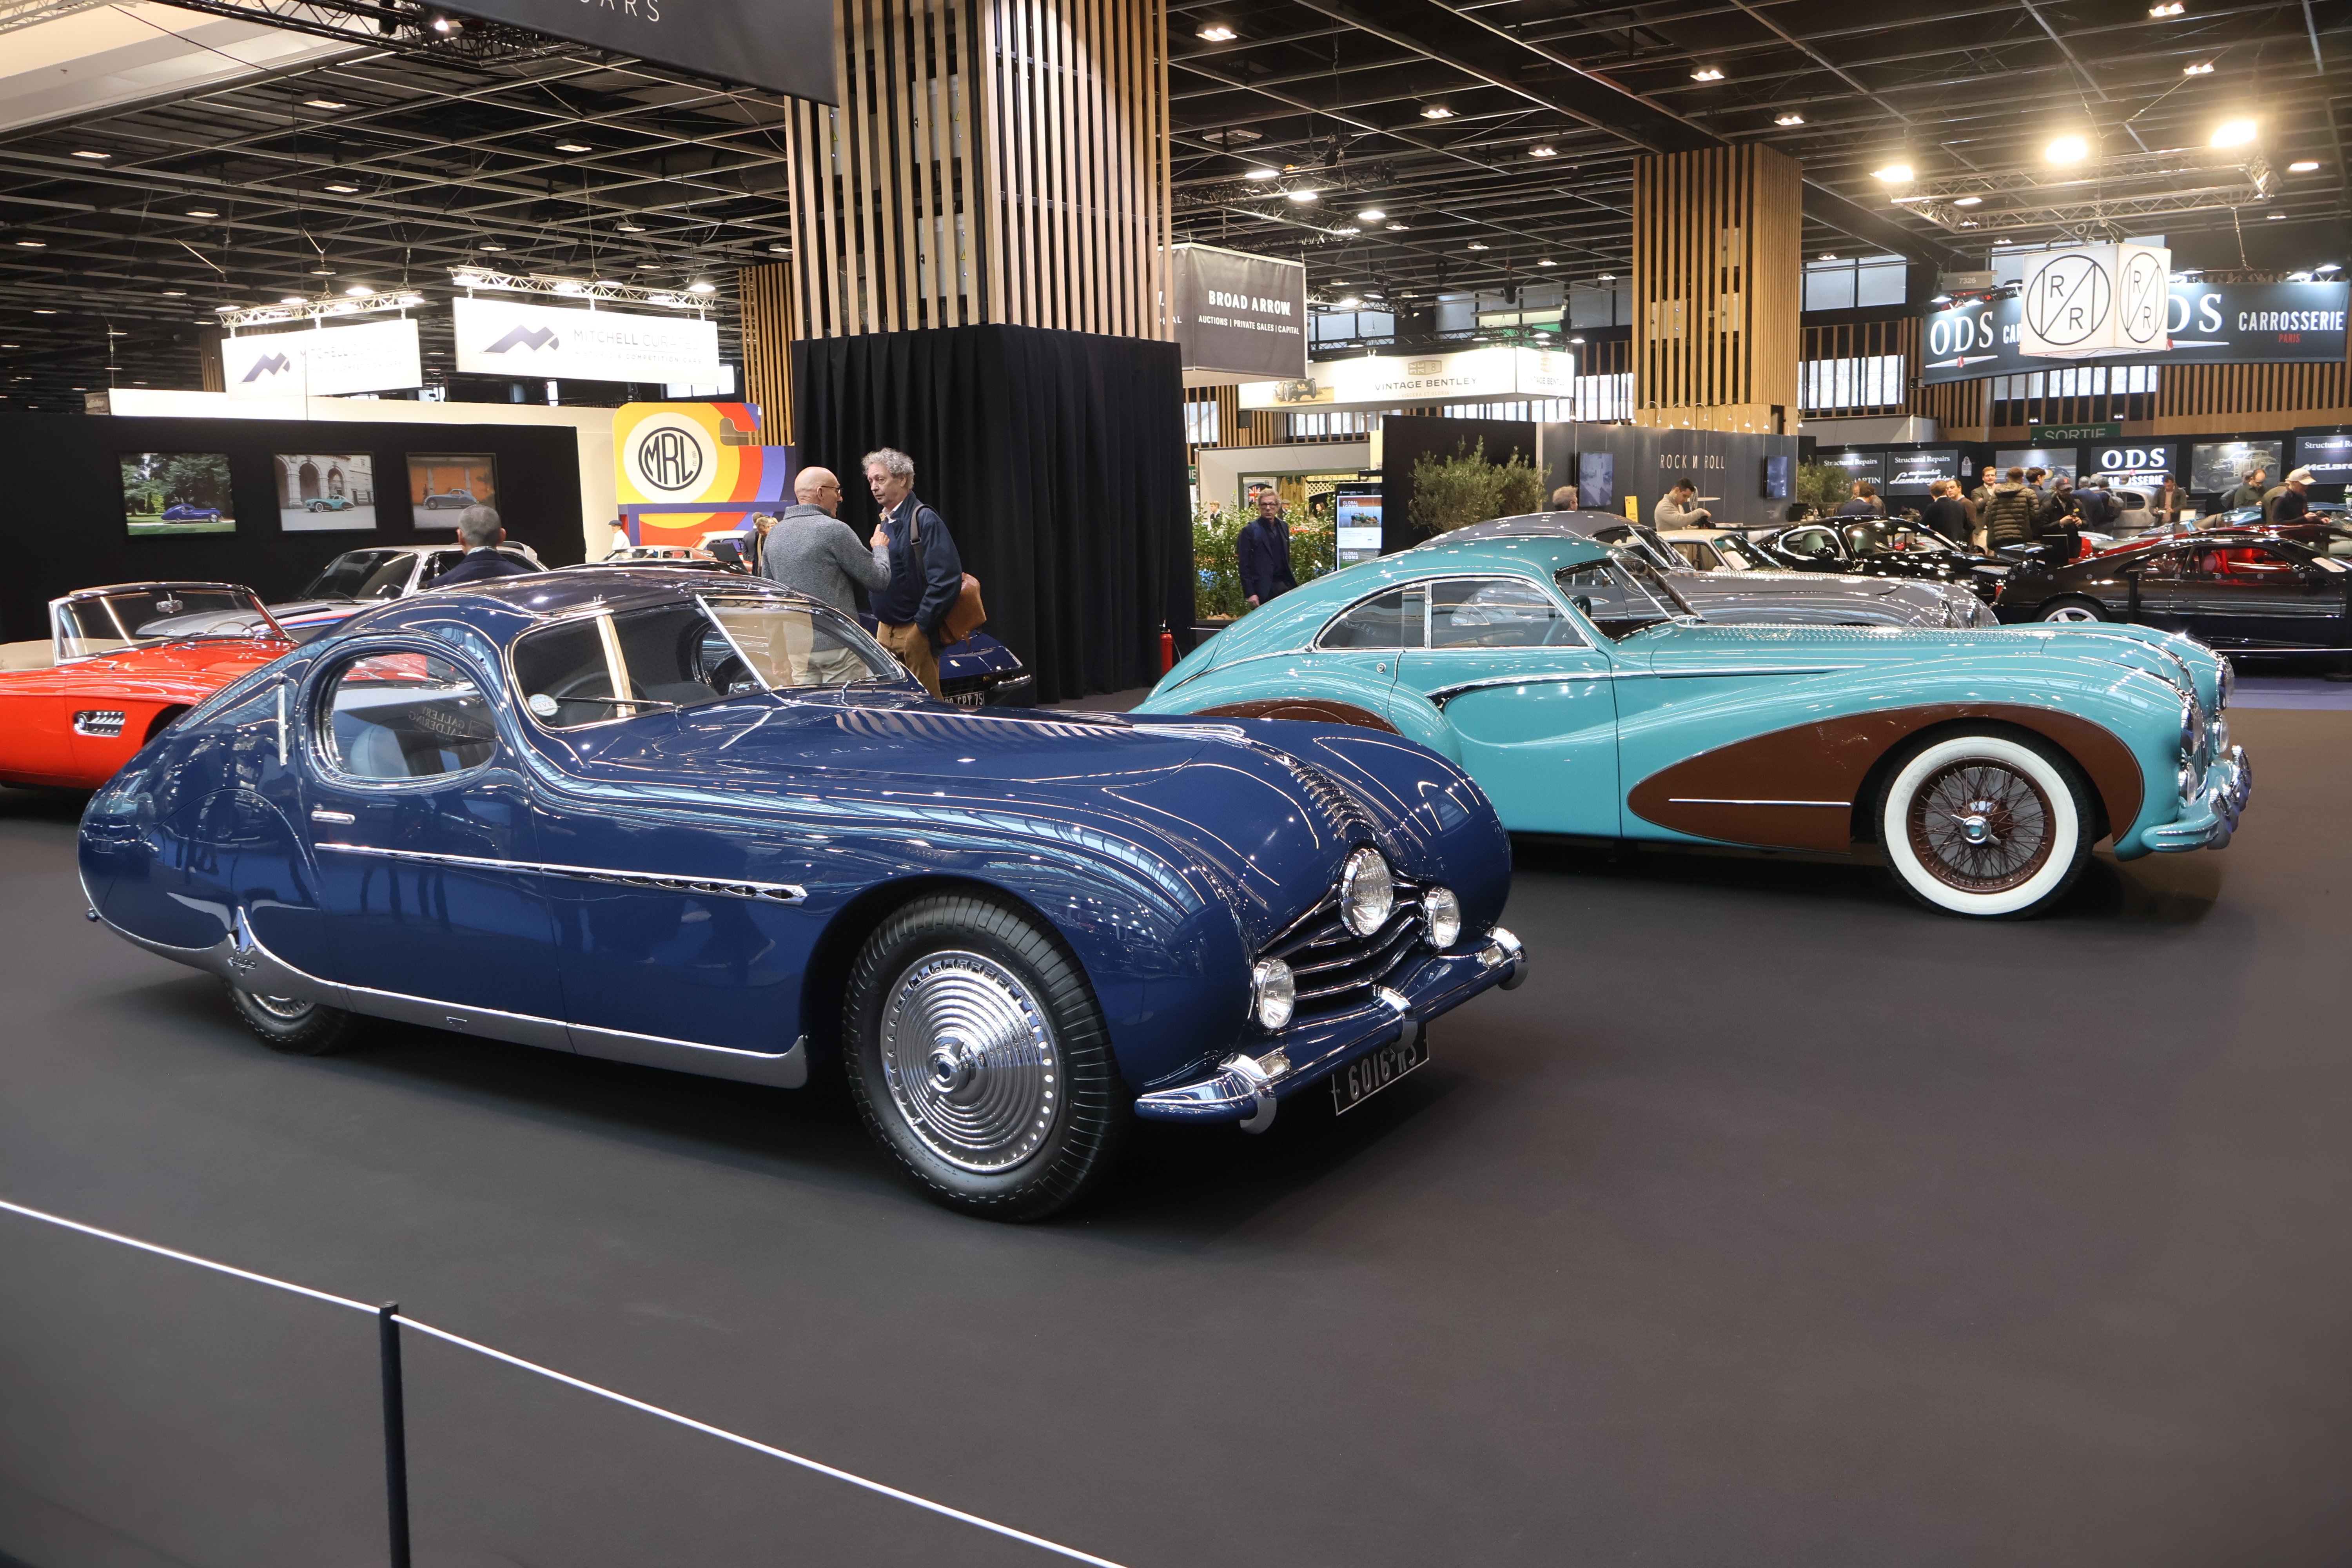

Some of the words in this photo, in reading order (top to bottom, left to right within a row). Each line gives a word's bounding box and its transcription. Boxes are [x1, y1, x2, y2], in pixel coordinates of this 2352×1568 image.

[580, 0, 659, 22] RS
[2050, 275, 2064, 298] R
[2133, 270, 2141, 293] R
[1209, 290, 1248, 309] BROAD
[2069, 307, 2083, 330] R
[2143, 306, 2151, 329] R
[2167, 293, 2223, 333] DS
[2238, 311, 2344, 331] CARROSSERIE
[1198, 315, 1228, 326] AUCTIONS
[1234, 319, 1255, 329] PRIVATE
[1257, 323, 1274, 332] SALES
[1278, 325, 1299, 335] CAPITAL
[1930, 311, 1993, 355] ODS
[574, 329, 638, 345] MITCHELL
[2278, 333, 2301, 343] PARIS
[626, 354, 679, 362] COMPETITION
[1375, 380, 1421, 391] VINTAGE
[1426, 377, 1477, 387] BENTLEY
[2305, 440, 2343, 449] Structural
[644, 433, 694, 485] MRL
[1660, 454, 1687, 469] ROCK
[1704, 455, 1725, 469] ROLL
[1855, 458, 1878, 466] Repairs
[1927, 456, 1951, 464] Repairs
[2101, 448, 2167, 469] ODS
[975, 693, 983, 706] 75
